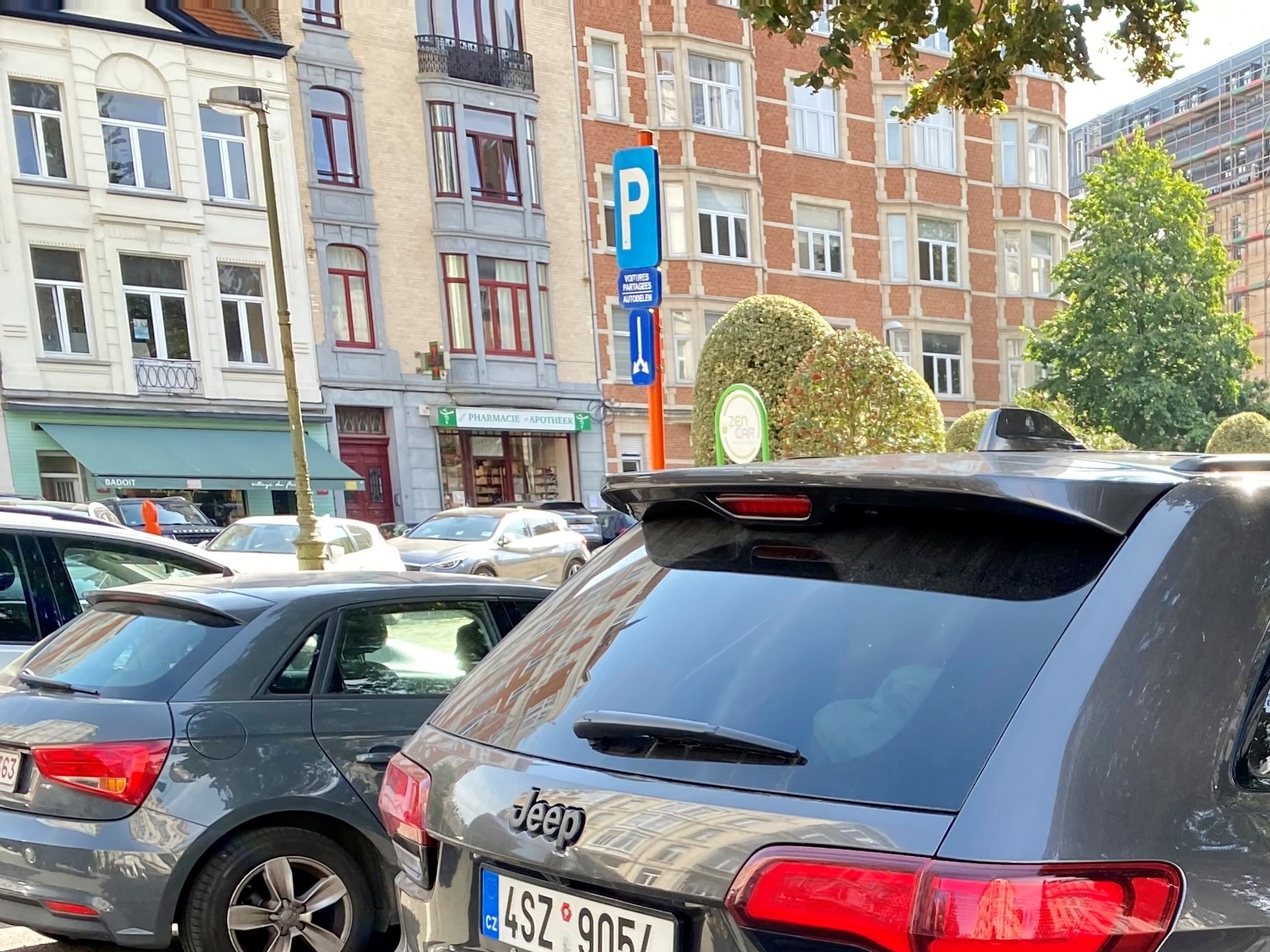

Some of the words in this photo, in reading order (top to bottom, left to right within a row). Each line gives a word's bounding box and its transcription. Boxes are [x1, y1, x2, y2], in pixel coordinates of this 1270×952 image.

[620, 167, 649, 250] P
[624, 272, 649, 282] VOITURES
[622, 282, 652, 291] PARTAGEES
[623, 294, 653, 303] AUTODELEN
[468, 413, 520, 423] PHARMACIE
[529, 415, 574, 425] APOTHEEK
[735, 427, 755, 439] CAR
[105, 478, 136, 486] BADOIT
[509, 787, 586, 850] Jeep
[485, 914, 498, 932] CZ
[504, 886, 553, 951] 4SZ
